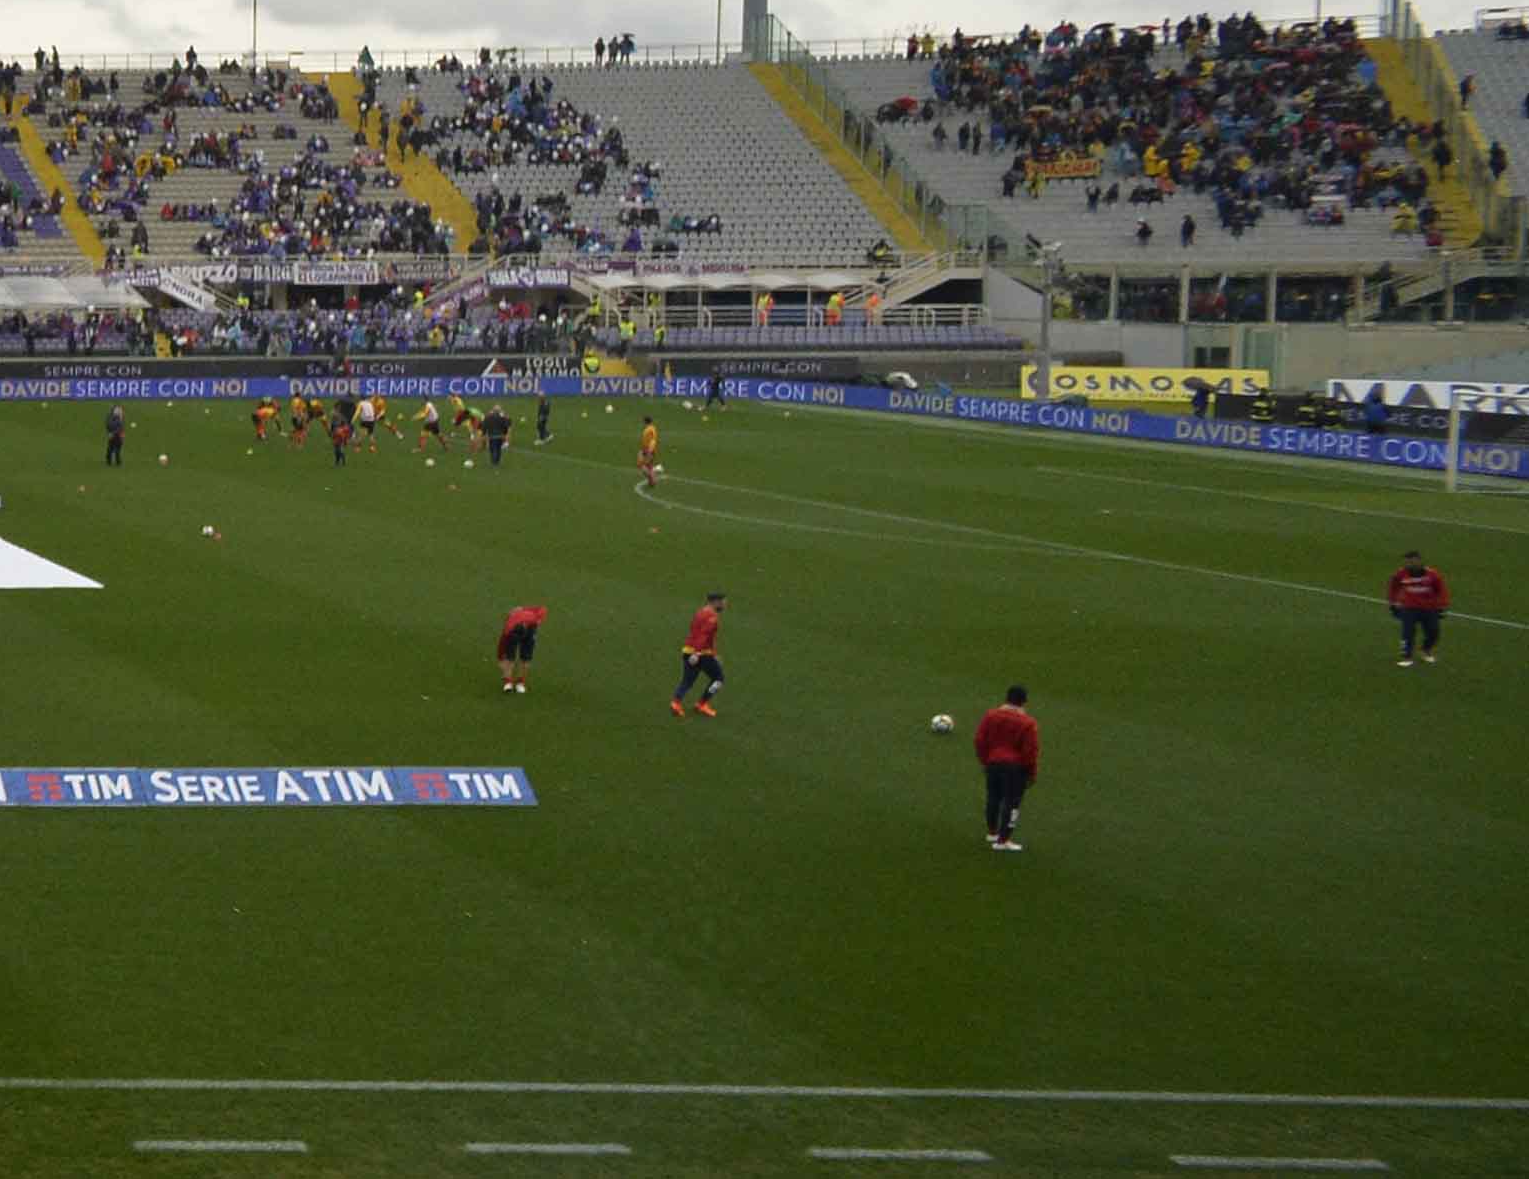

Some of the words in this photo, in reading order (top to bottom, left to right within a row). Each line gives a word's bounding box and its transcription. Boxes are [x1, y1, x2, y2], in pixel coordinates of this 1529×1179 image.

[44, 365, 101, 377] SEMPRE
[106, 365, 142, 376] CON
[0, 380, 70, 398] DAVIDE
[76, 380, 151, 397] SEMPRE
[157, 380, 205, 397] CON
[211, 380, 247, 396] NOI
[290, 378, 360, 395] DAVIDE
[365, 378, 441, 395] SEMPRE
[448, 377, 496, 395] CON
[502, 378, 539, 395] NOI
[581, 377, 655, 395] DAVIDE
[661, 379, 749, 397] SEMRE
[757, 381, 806, 400] CON
[811, 387, 845, 403] NOI
[890, 391, 955, 414] DAVIDE
[957, 397, 1032, 421] SEMPRE
[1037, 404, 1085, 428] CON
[1091, 412, 1131, 433] NOI
[1174, 417, 1262, 447] DAVIDE
[1268, 427, 1370, 459] SEMPRE
[1379, 437, 1451, 466] CON
[1463, 448, 1523, 473] NOI
[62, 773, 134, 801] TIM
[149, 770, 267, 804] SERIE
[302, 770, 395, 803] TIM
[447, 773, 523, 800] TIM
